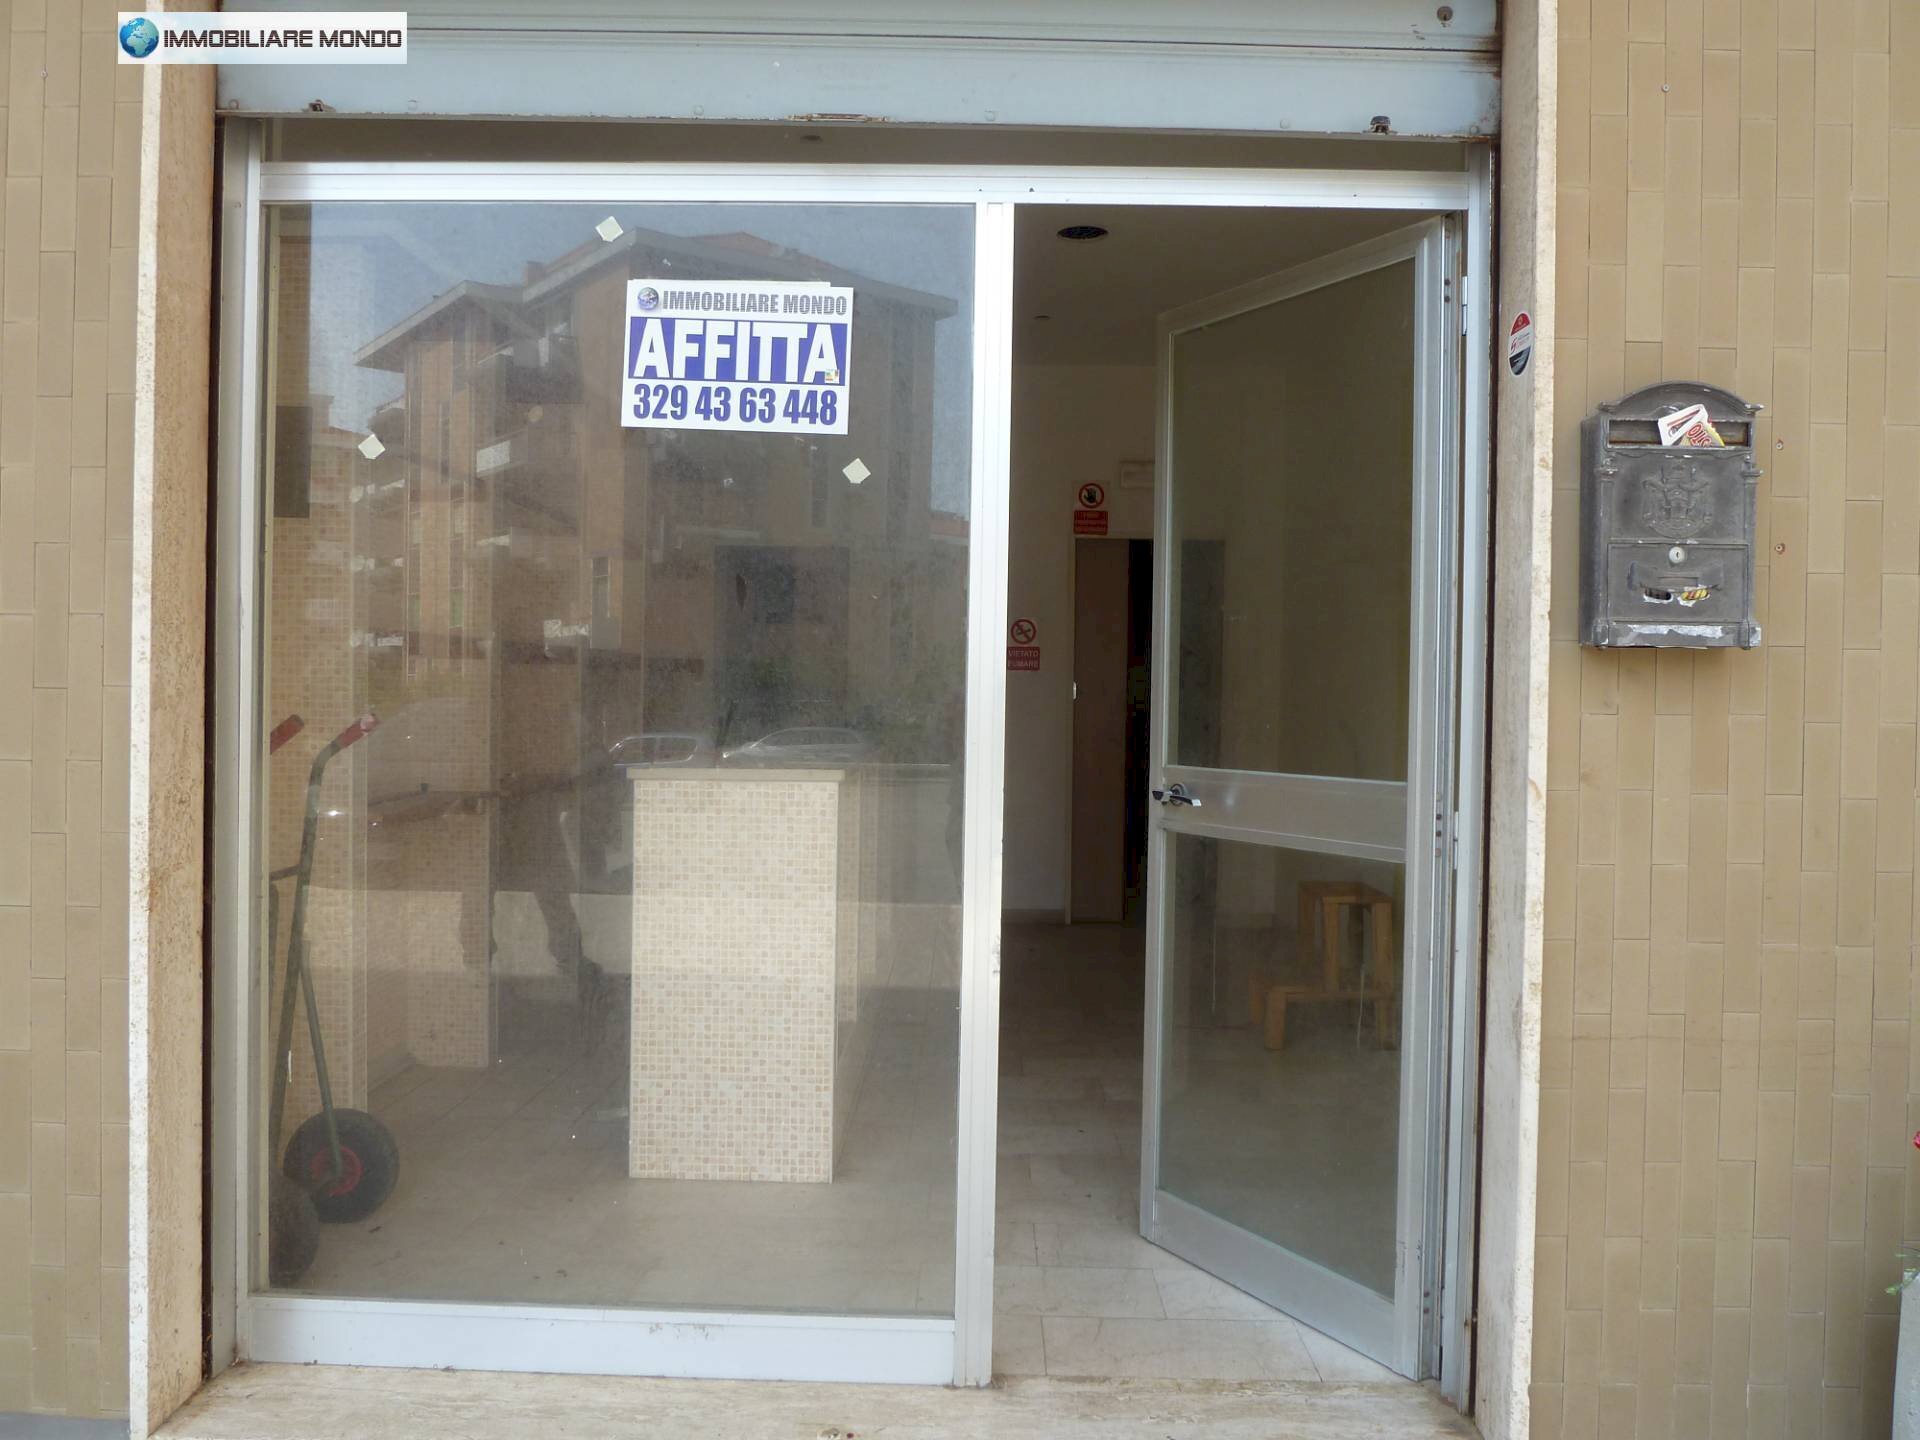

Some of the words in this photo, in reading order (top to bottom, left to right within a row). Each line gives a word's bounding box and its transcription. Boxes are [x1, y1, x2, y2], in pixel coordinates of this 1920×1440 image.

[662, 290, 780, 314] IMMOBILIARE
[783, 294, 848, 316] MONDO
[632, 317, 840, 385] AFFITTA
[633, 383, 689, 421] 329
[694, 386, 732, 422] 43
[738, 387, 777, 424] 63
[783, 389, 838, 426] 448
